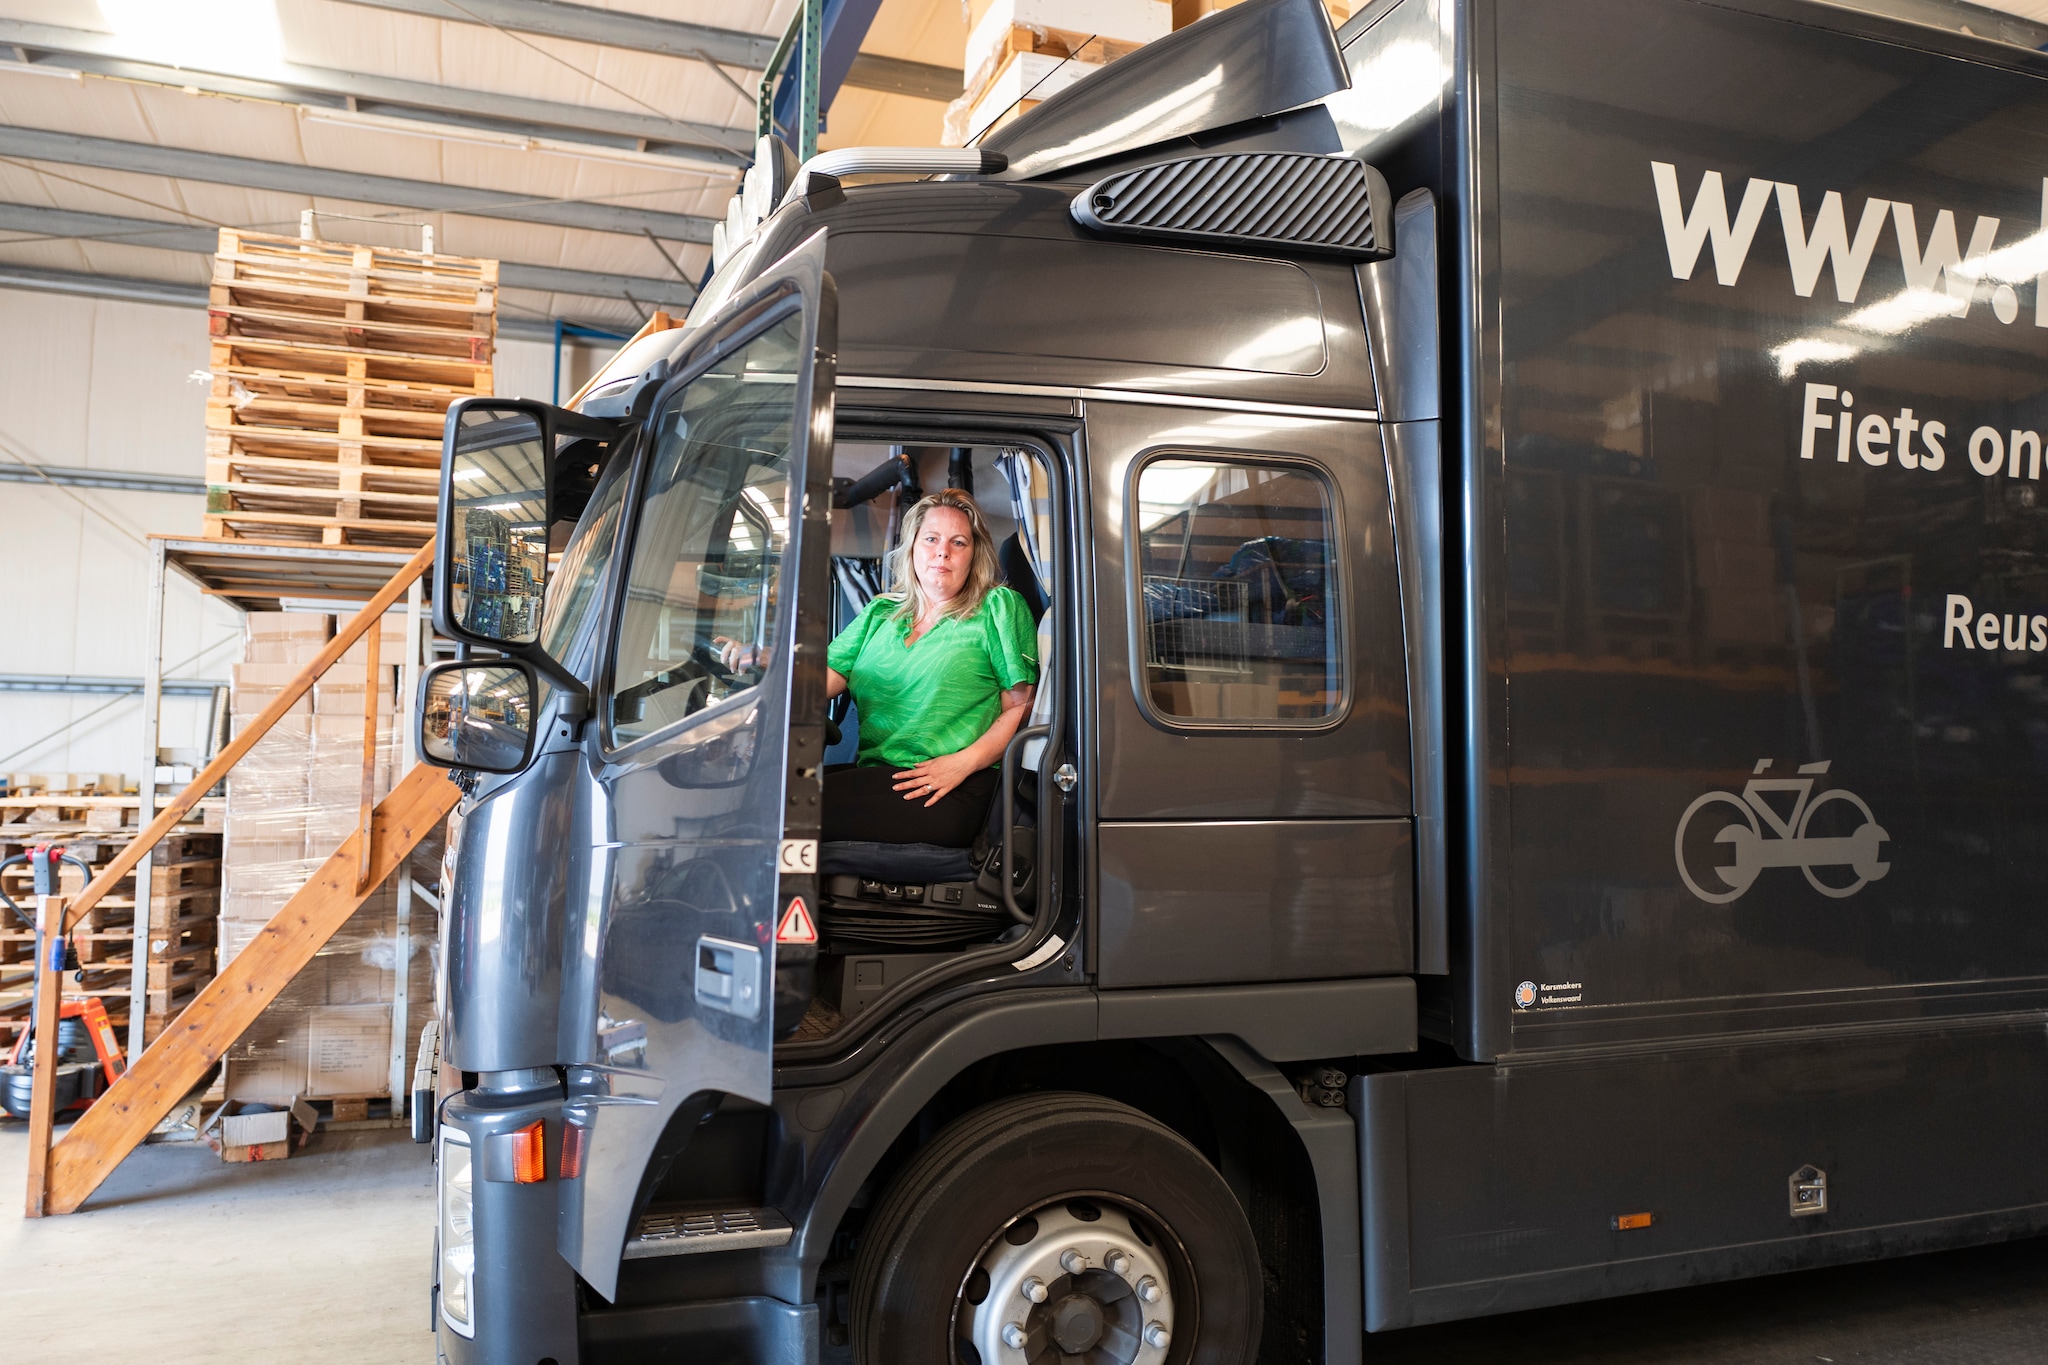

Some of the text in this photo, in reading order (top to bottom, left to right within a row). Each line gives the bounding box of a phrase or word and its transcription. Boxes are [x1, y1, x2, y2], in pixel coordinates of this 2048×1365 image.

[1651, 161, 2048, 328] www.
[1800, 382, 2048, 480] Fiets on
[1943, 593, 2048, 652] Reus
[782, 844, 811, 866] CE
[1540, 981, 1582, 991] Karsmakers
